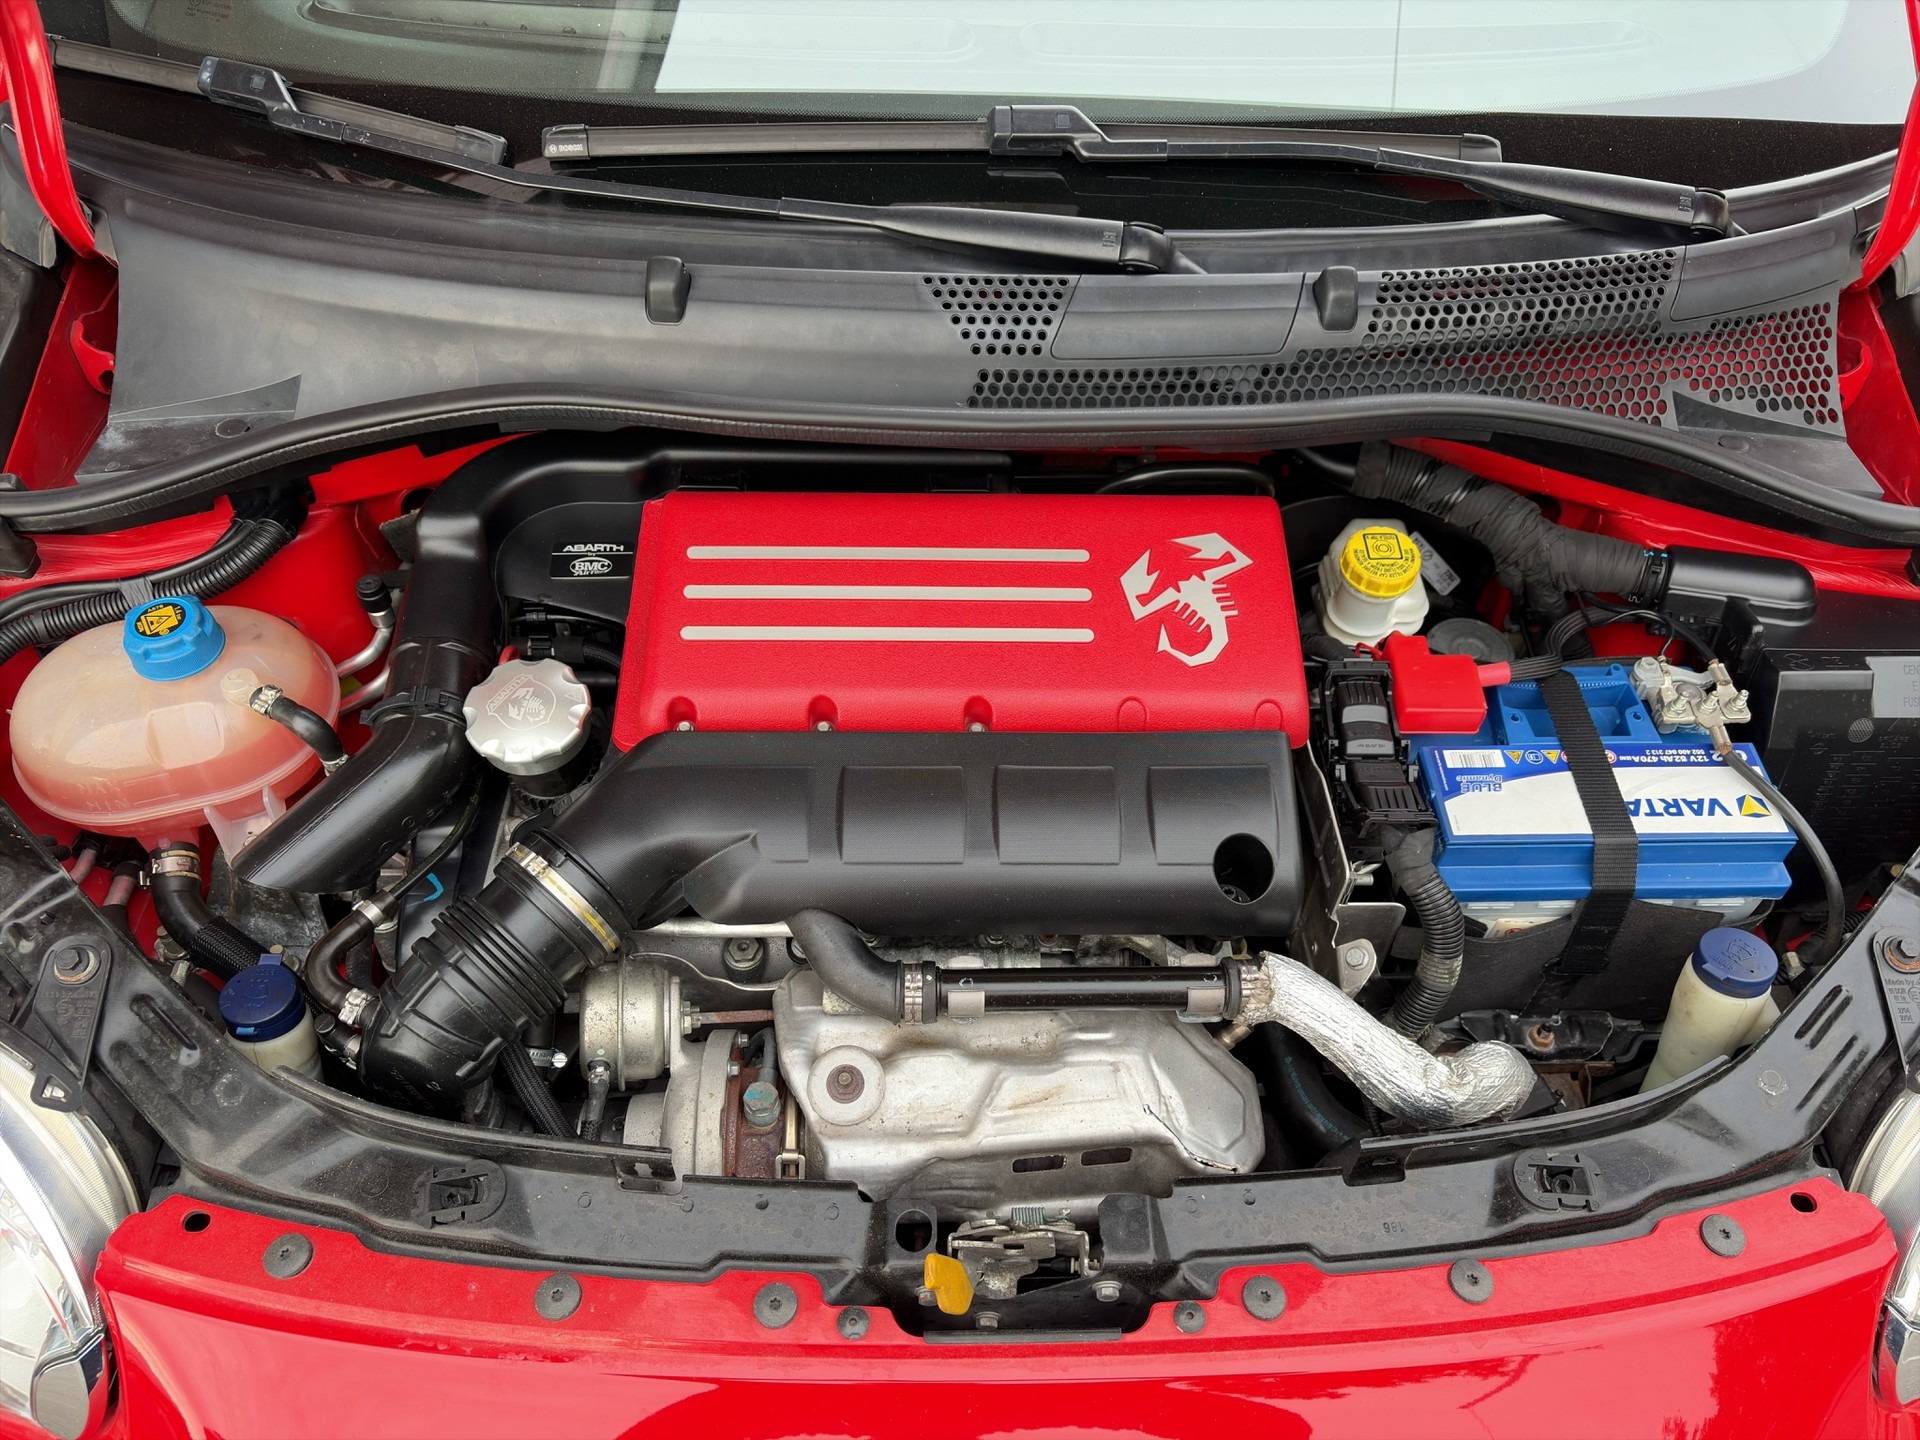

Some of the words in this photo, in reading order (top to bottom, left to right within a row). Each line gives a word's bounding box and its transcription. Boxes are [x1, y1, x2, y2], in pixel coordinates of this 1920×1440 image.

[562, 543, 624, 552] ABARTH
[574, 562, 609, 571] BMC
[1904, 664, 1920, 676] CEN
[489, 675, 527, 710] ABARTH
[1904, 696, 1920, 708] FUS
[1456, 774, 1502, 783] Dynamic
[1460, 782, 1502, 793] BLUE
[1624, 798, 1733, 817] VARTA
